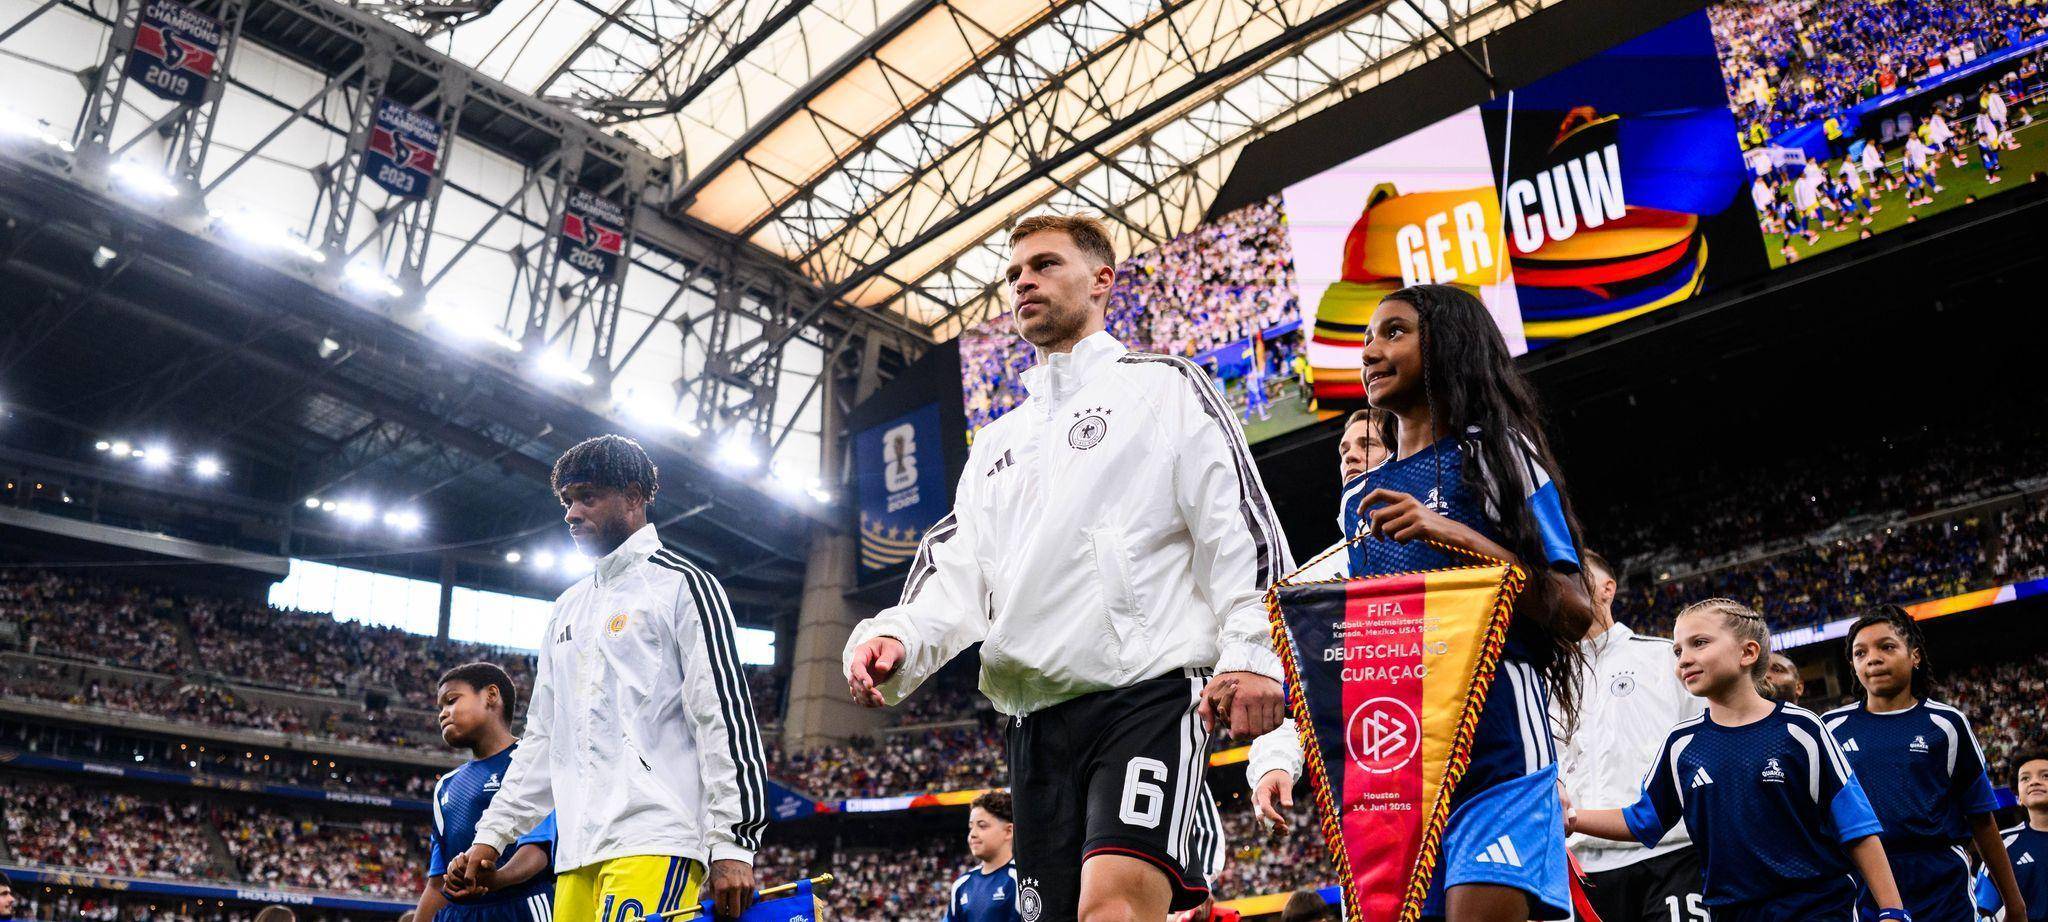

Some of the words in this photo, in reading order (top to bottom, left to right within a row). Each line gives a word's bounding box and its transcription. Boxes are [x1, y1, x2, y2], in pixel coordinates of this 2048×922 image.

[146, 5, 219, 45] CHAMPIONS
[181, 8, 214, 32] SOUTH
[145, 65, 189, 95] 2019
[379, 164, 415, 192] 2023
[1396, 200, 1493, 289] GER
[1507, 143, 1626, 254] CUW
[569, 247, 605, 273] 2024
[1367, 603, 1404, 617] FIFA
[1332, 618, 1440, 630] Fußball-Weltmeistersc
[1333, 631, 1363, 639] Kanada,
[1399, 626, 1416, 634] USA
[1324, 641, 1447, 661] DEUTSCHLAND
[1341, 664, 1428, 685] CURAÇAO
[326, 792, 392, 807] HOUSTON
[1119, 756, 1168, 829] 6
[1363, 792, 1400, 800] Houston
[1370, 803, 1387, 811] Juni
[237, 886, 314, 905] HOUSTON
